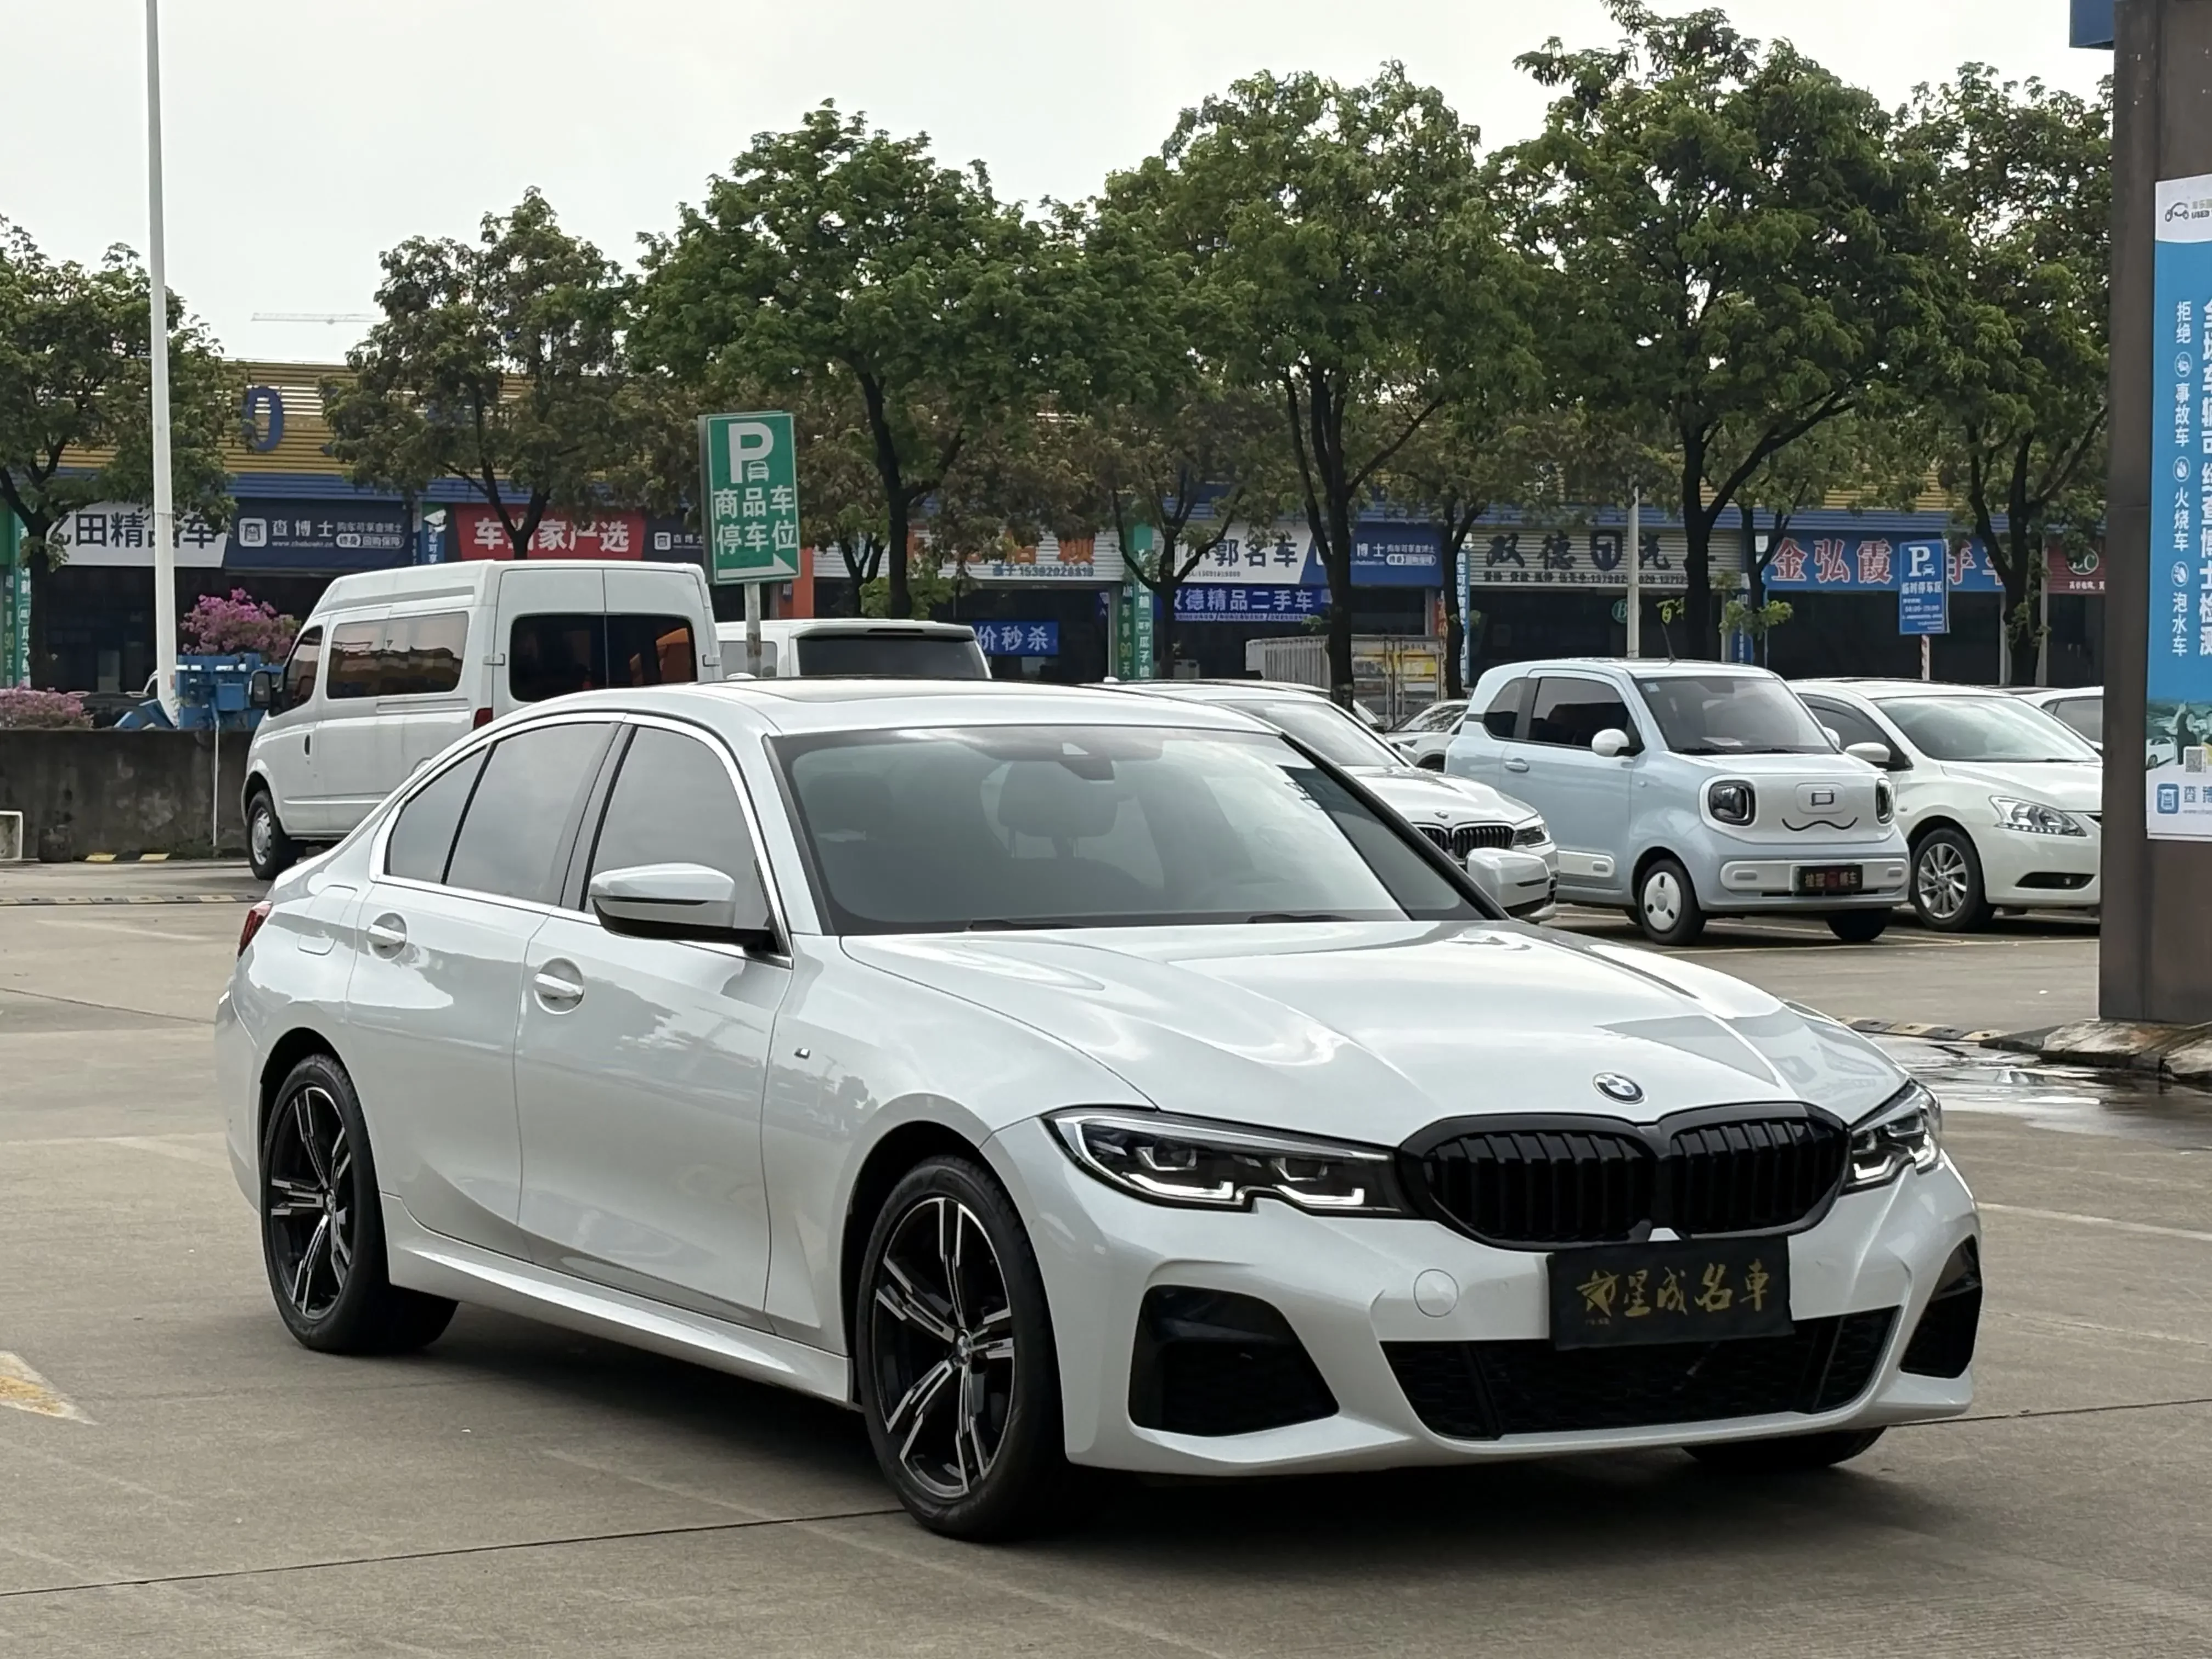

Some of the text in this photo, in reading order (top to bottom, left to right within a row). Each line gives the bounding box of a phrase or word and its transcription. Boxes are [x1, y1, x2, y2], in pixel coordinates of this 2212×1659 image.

[2176, 301, 2192, 344] 拒绝
[2175, 382, 2190, 447] 事故车
[728, 422, 774, 483] P
[714, 484, 795, 520] 商品车
[2173, 487, 2190, 552] 火烧车
[272, 520, 334, 538] 查博士
[473, 517, 629, 553] 车家严选
[716, 520, 797, 555] 停车位
[1184, 538, 1299, 568] 郭名车
[1908, 546, 1930, 577] P
[2172, 591, 2188, 657] 泡水车
